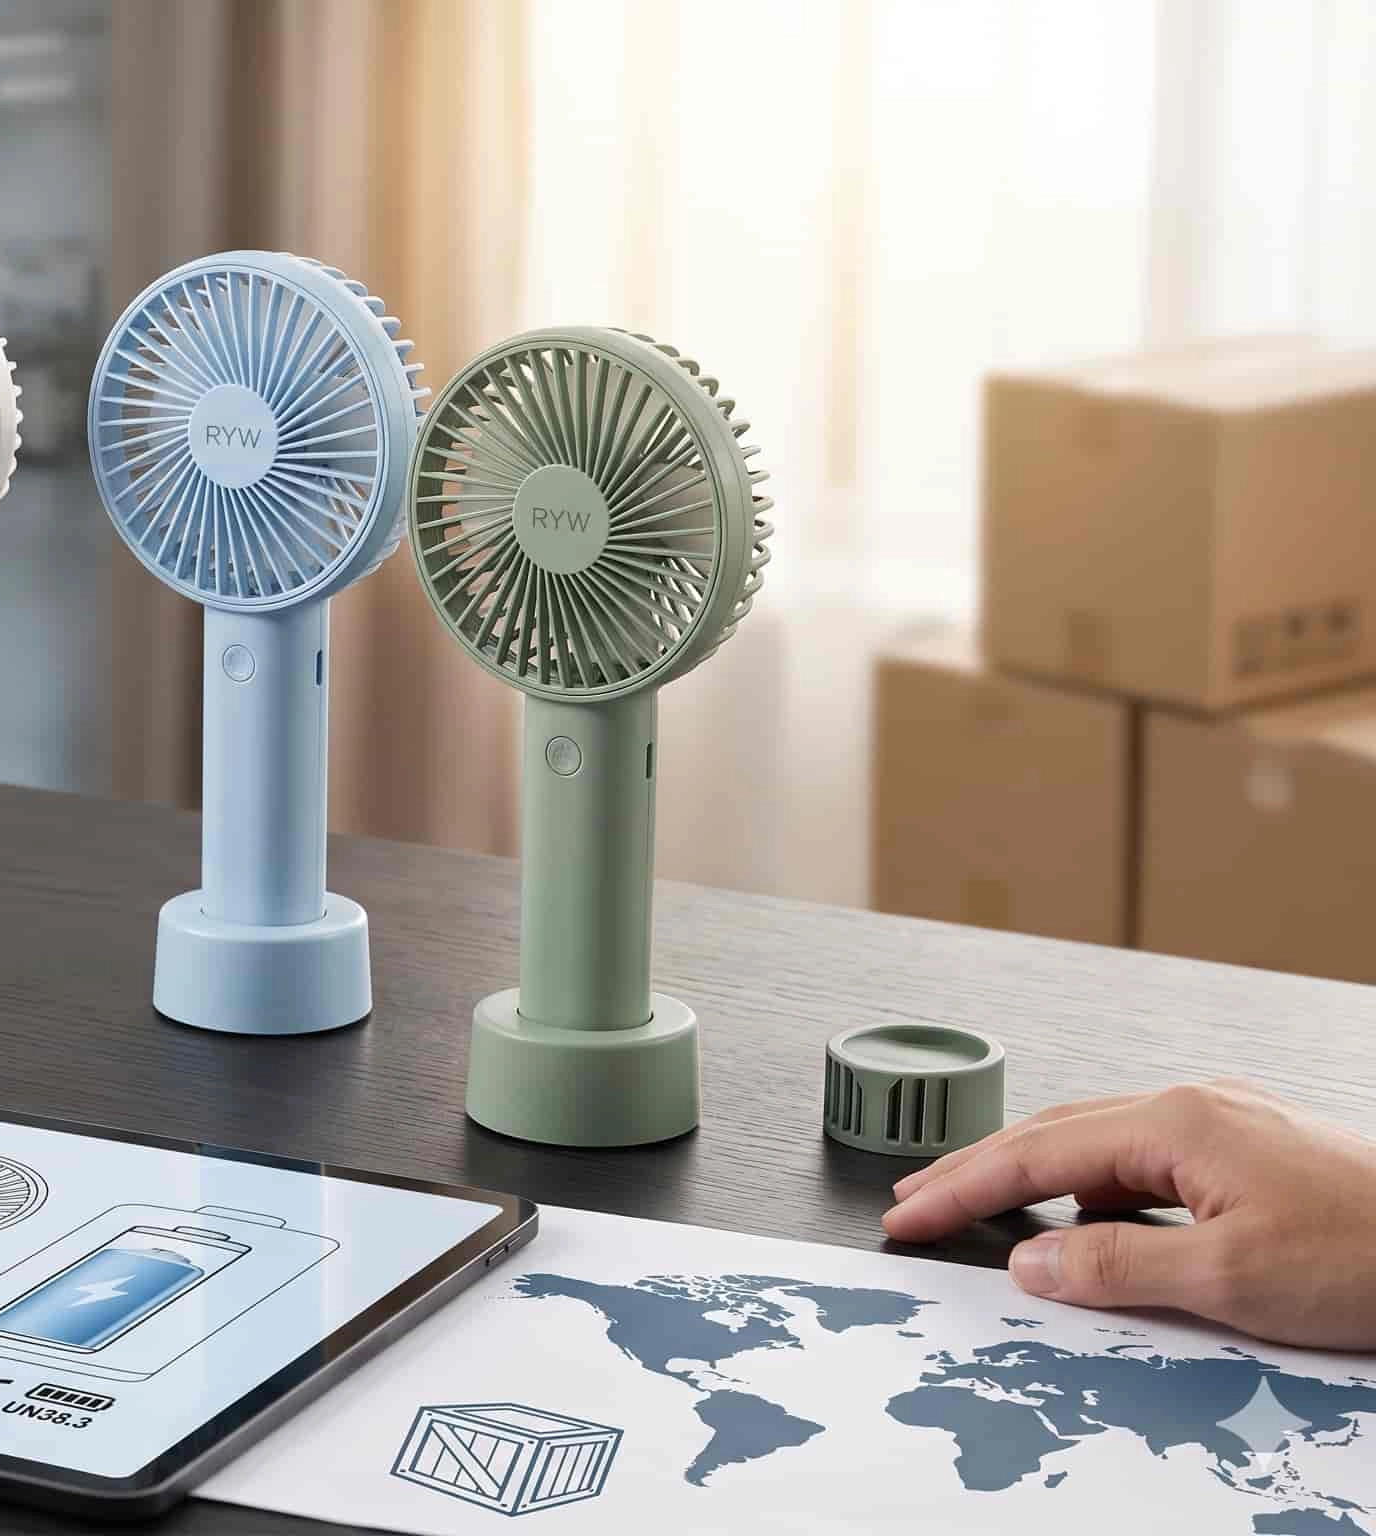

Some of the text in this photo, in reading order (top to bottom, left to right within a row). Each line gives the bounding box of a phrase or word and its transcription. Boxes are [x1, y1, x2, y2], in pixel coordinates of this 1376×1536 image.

[206, 425, 262, 449] RYW
[532, 507, 591, 533] RYW
[1, 1400, 94, 1429] UN38.3
